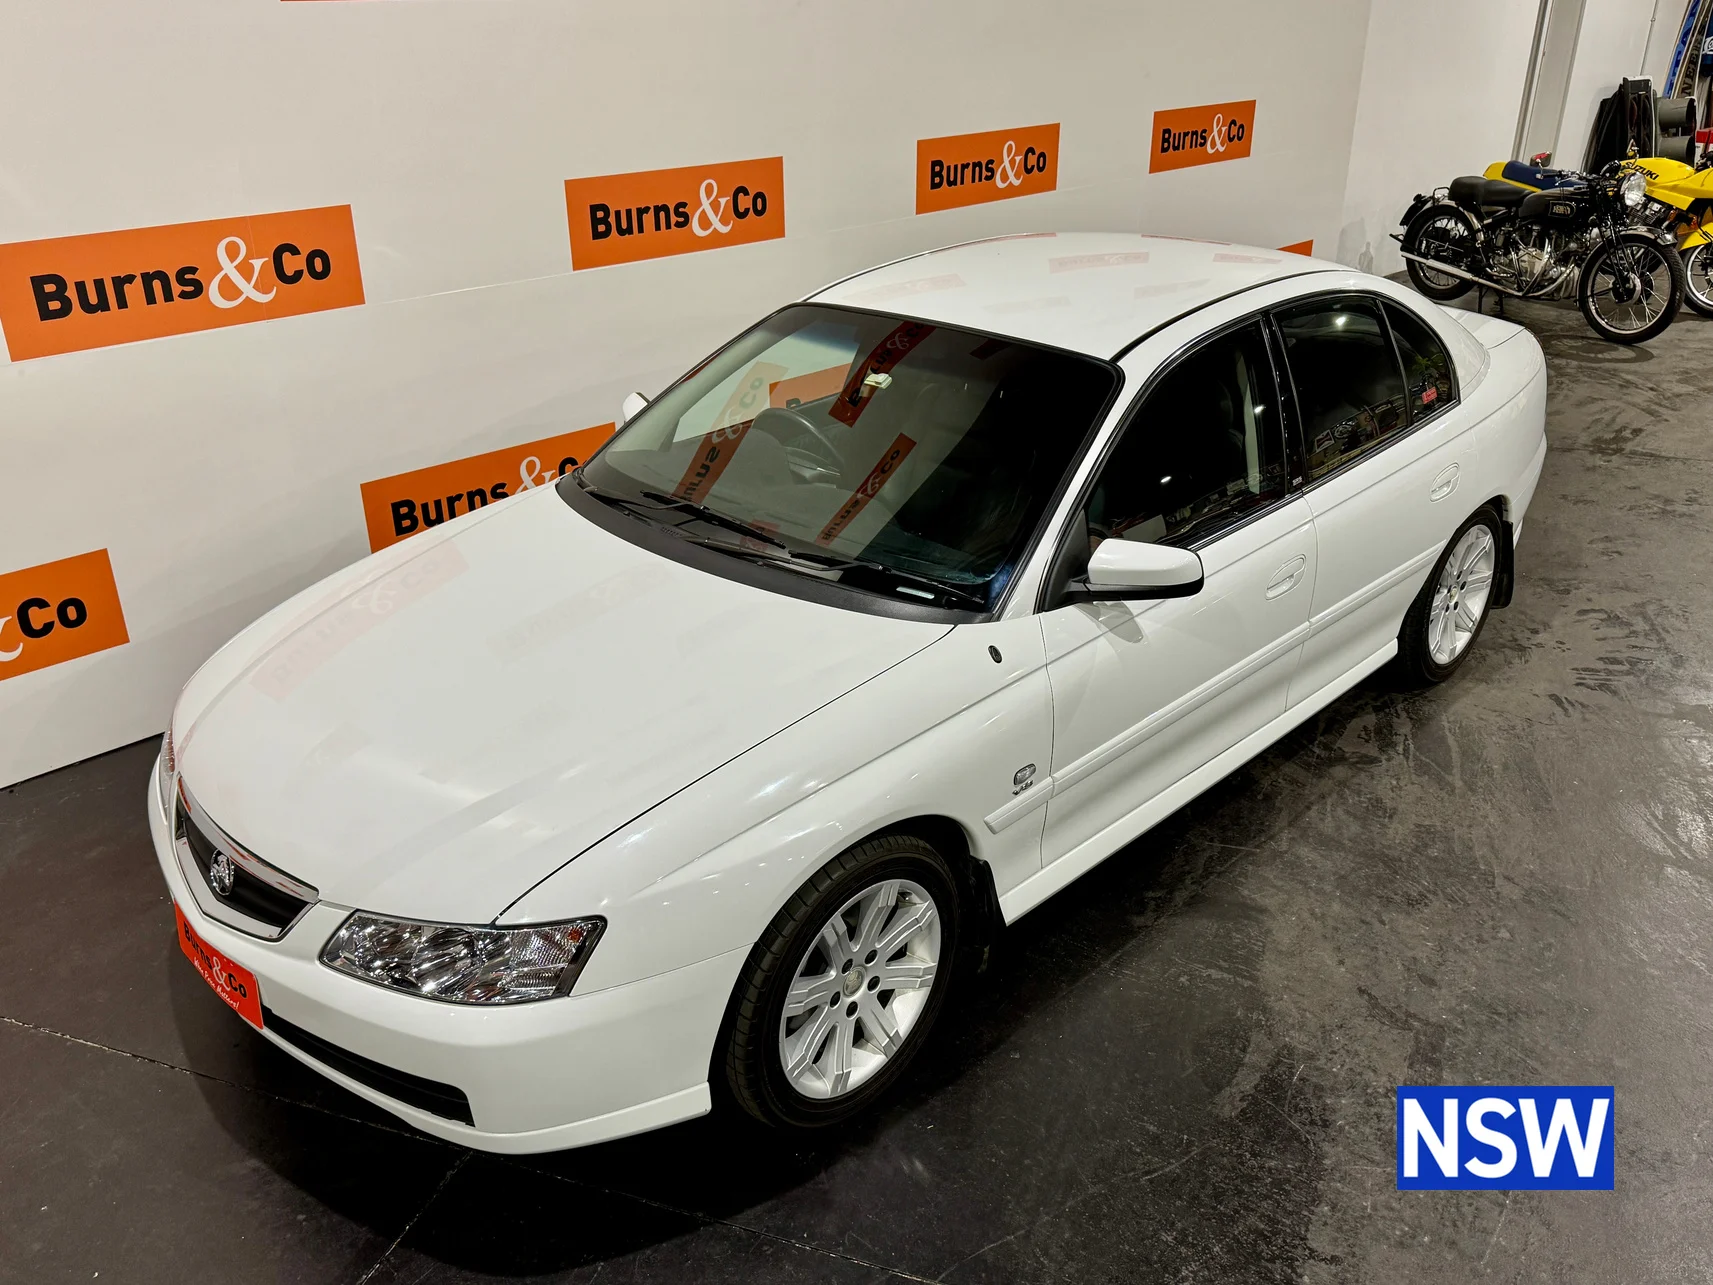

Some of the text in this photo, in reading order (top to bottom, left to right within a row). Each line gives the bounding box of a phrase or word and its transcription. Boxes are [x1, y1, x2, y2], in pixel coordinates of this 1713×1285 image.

[1160, 113, 1245, 153] Burns&Co
[930, 140, 1047, 190] Burns&Co
[1625, 161, 1659, 180] SUZUKI
[589, 179, 767, 240] Burns&Co
[30, 236, 332, 321] Burns&Co
[391, 456, 587, 536] Burns&C
[184, 921, 247, 998] Burns&Co
